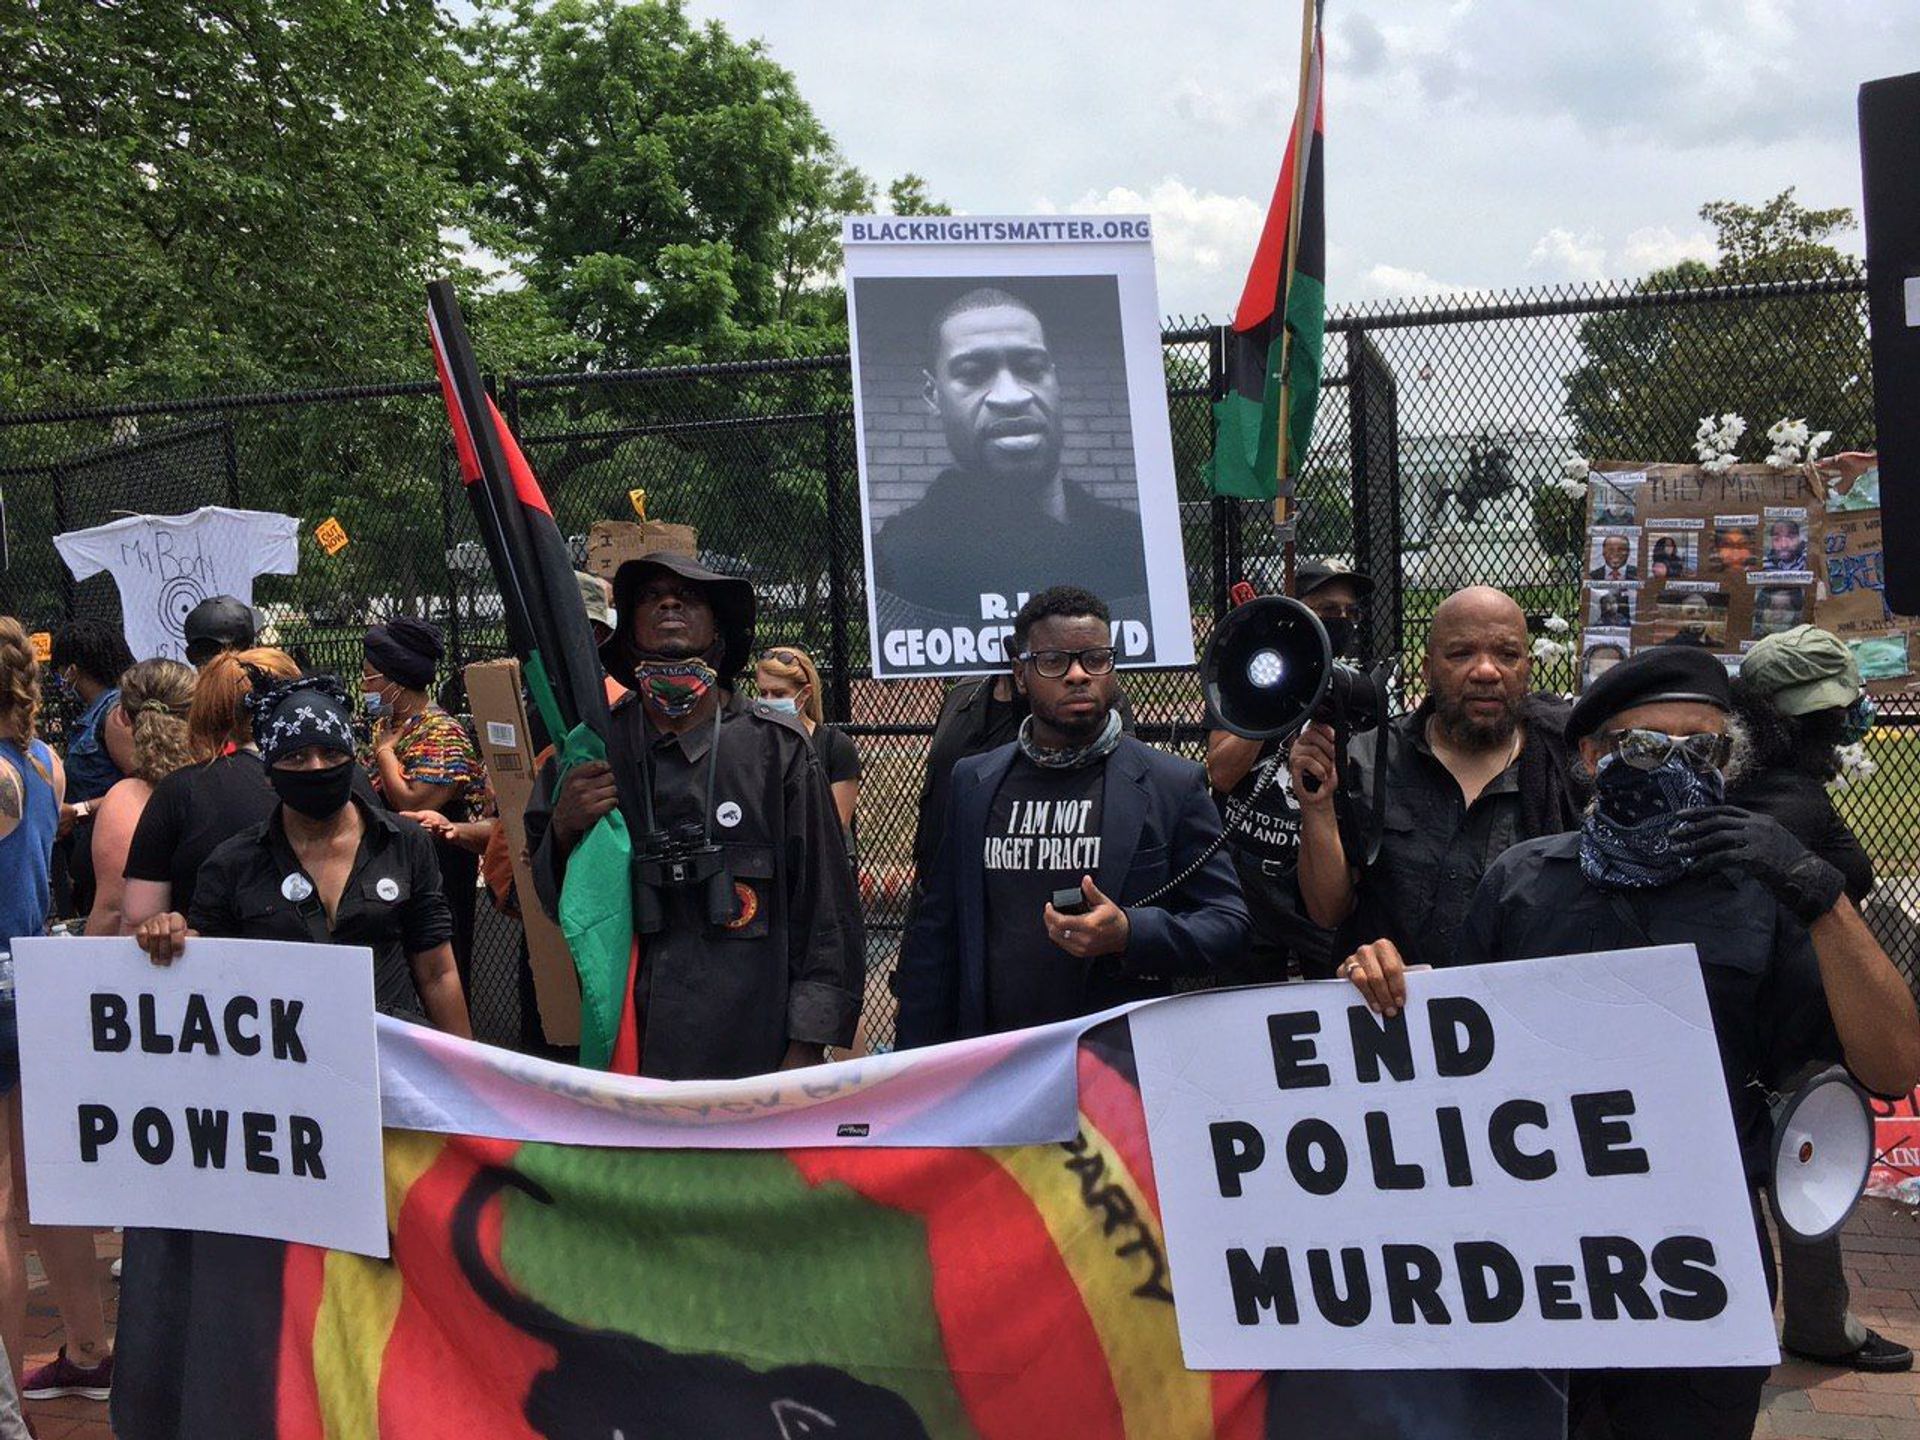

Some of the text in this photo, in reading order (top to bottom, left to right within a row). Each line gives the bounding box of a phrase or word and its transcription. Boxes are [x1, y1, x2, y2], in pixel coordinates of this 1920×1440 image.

[851, 218, 1150, 242] BLACKRIGHTSMATTER.ORG
[1647, 473, 1706, 502] THEY
[320, 524, 338, 542] OUT
[1007, 799, 1092, 834] I AM NOT
[1255, 811, 1271, 826] TO
[1273, 817, 1297, 831] THE
[984, 836, 1101, 870] ARGET PRACTI
[1253, 827, 1289, 846] AND
[89, 993, 307, 1063] BLACK
[1266, 996, 1495, 1090] END
[77, 1103, 327, 1180] POWER
[1208, 1089, 1650, 1198] POLICE
[1225, 1235, 1728, 1328] MURDERS
